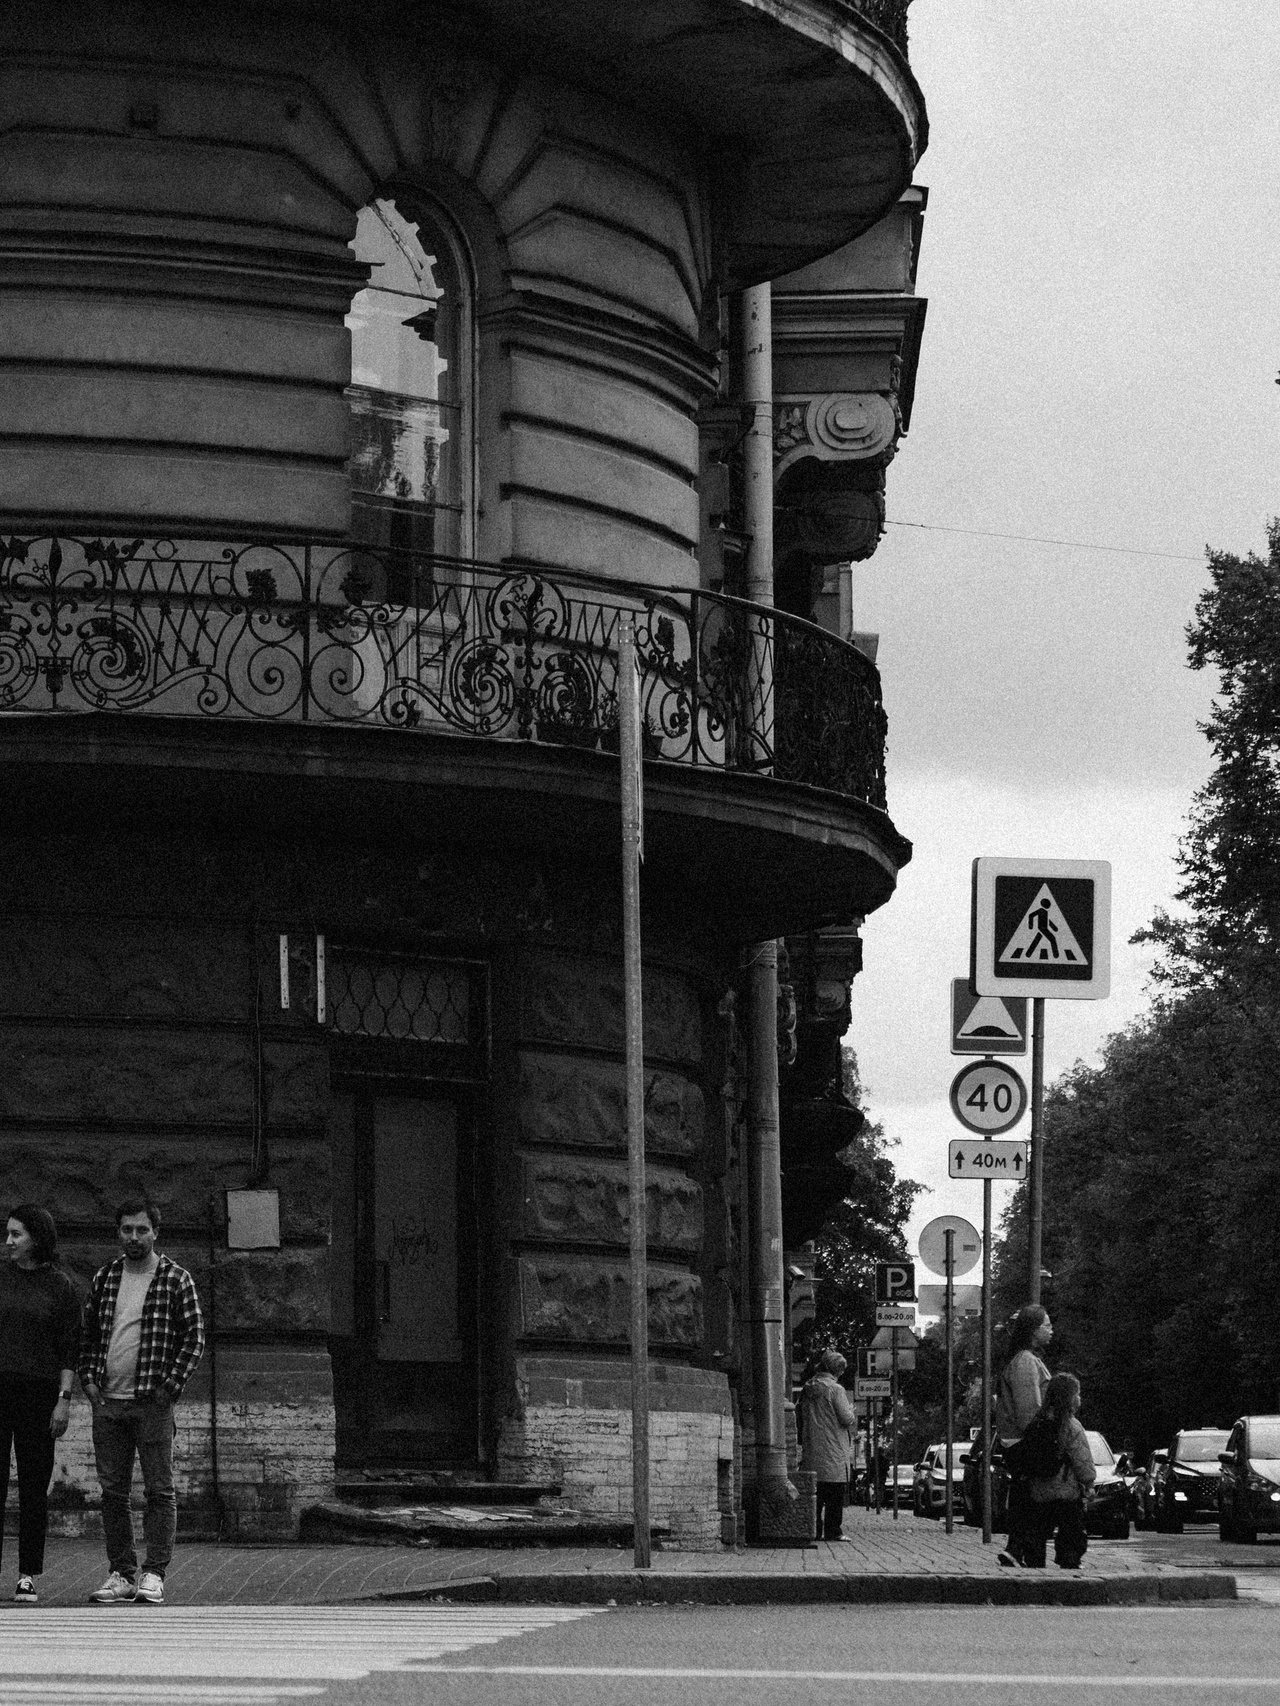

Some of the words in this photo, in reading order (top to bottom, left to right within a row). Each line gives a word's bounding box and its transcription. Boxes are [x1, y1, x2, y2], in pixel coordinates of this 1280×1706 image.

[965, 1083, 1013, 1113] 40
[886, 1267, 908, 1298] P
[877, 1312, 914, 1321] 8.00-20.00
